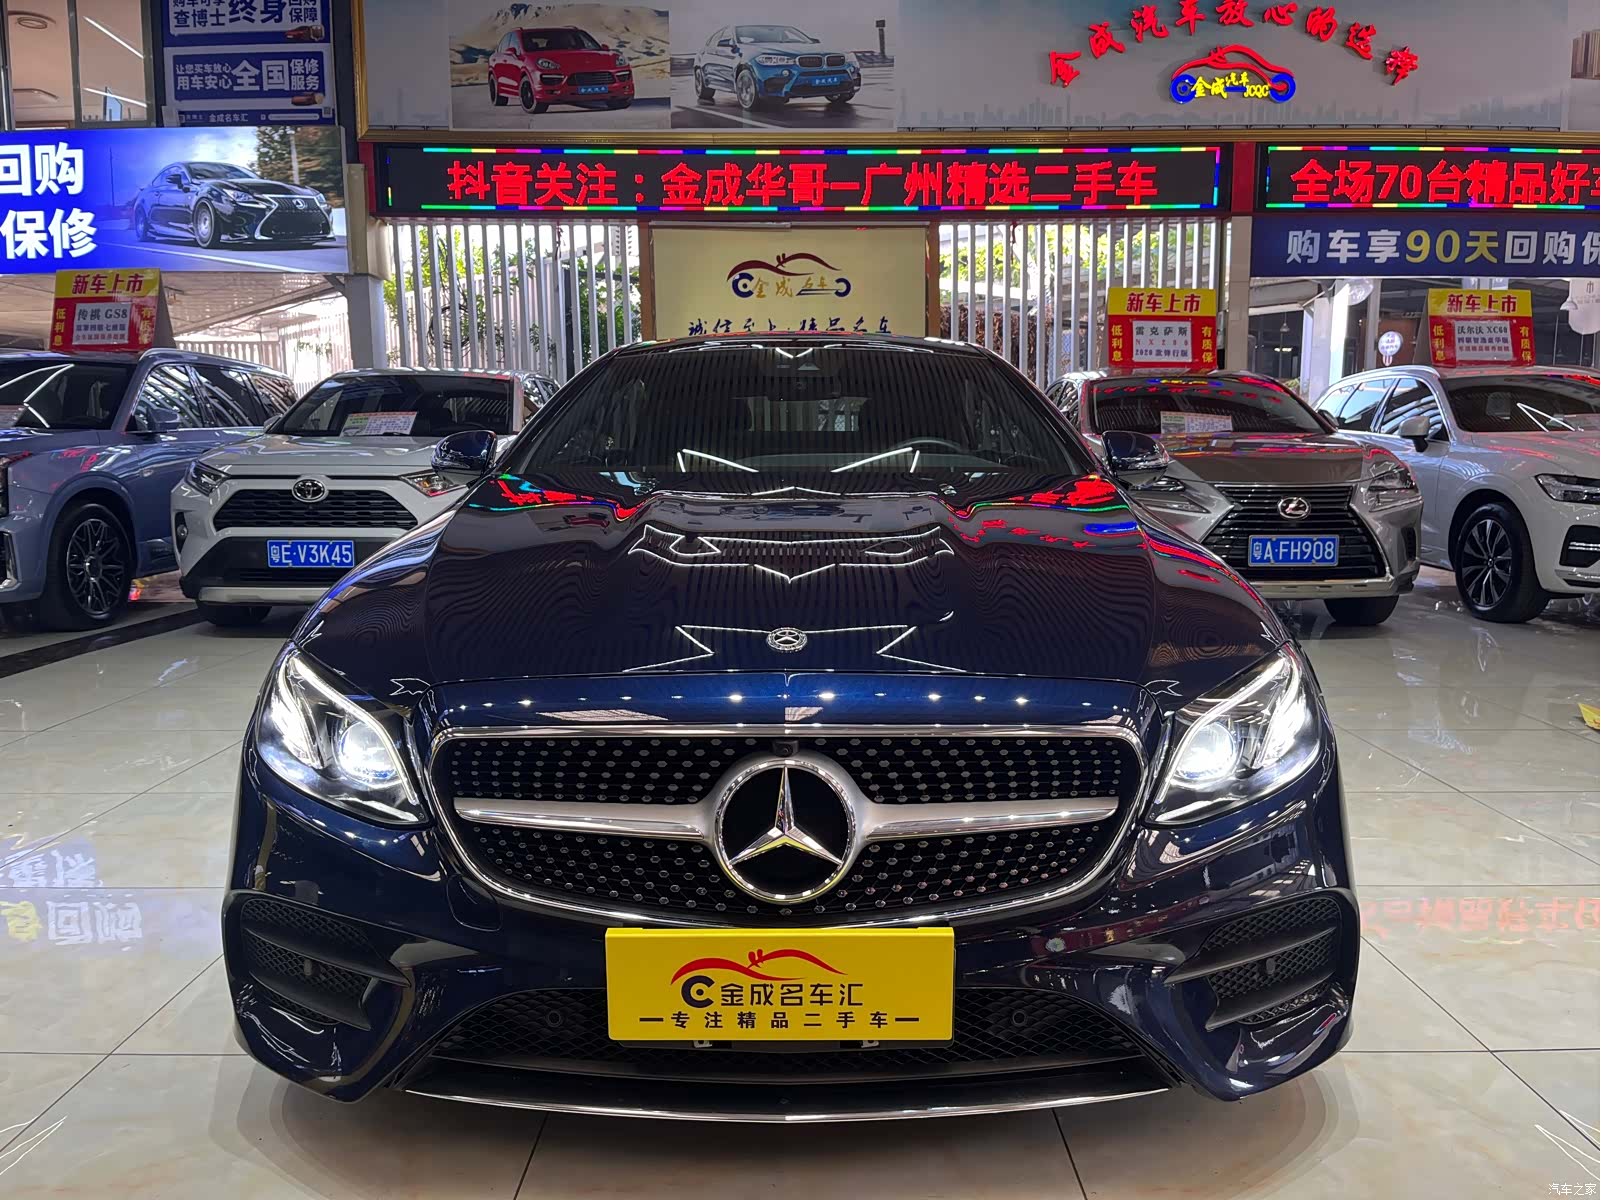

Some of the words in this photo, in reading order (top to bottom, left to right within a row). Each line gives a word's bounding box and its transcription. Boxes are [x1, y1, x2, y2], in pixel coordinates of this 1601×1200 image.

[174, 8, 226, 28] 查博士
[289, 8, 319, 23] 保障
[175, 63, 232, 75] 让您买车放心
[231, 60, 290, 91] 全国
[290, 59, 319, 74] 保修
[177, 75, 232, 91] 用车安心
[291, 75, 319, 91] 服务
[1244, 85, 1269, 98] JCQC
[1290, 158, 1600, 204] 全场70台精品好
[0, 207, 98, 260] 保修
[71, 273, 144, 295] 新车上市
[1126, 292, 1201, 313] 新车上市
[1447, 294, 1517, 314] 新车上市
[104, 308, 128, 319] GS8
[52, 308, 67, 346] 低利息
[1135, 326, 1188, 336] 雷克萨斯
[1457, 325, 1484, 335] 沃尔沃
[1111, 325, 1123, 361] 低利息
[1201, 326, 1213, 363] 有质保
[1433, 325, 1446, 361] 低利息
[1519, 326, 1533, 362] 有质保
[720, 983, 864, 1007] 金成名车汇
